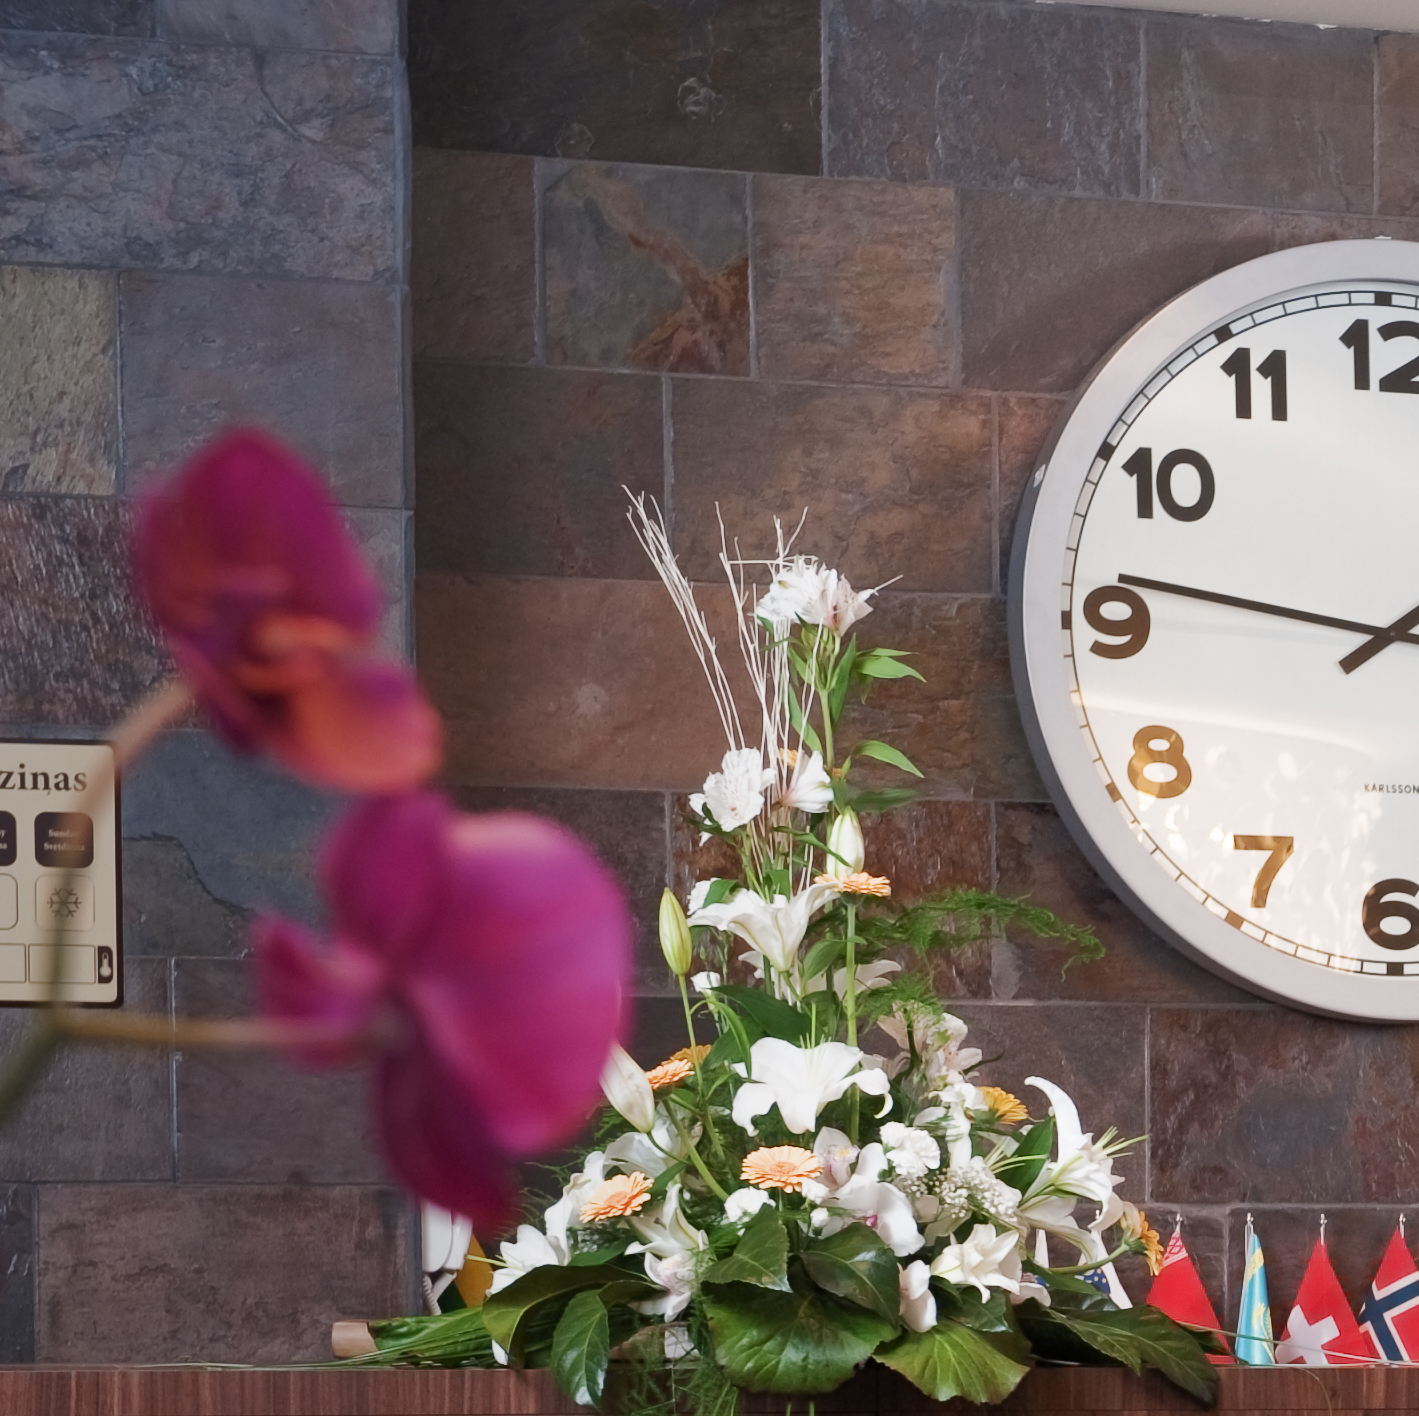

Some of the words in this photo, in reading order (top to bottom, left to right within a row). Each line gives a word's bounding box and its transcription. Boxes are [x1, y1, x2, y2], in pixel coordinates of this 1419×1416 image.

[1219, 347, 1288, 422] 11
[1121, 446, 1216, 523] 10
[1082, 585, 1151, 660] 9
[1127, 724, 1193, 799] 8
[1364, 783, 1419, 794] KARLSSON
[1232, 834, 1294, 909] 7
